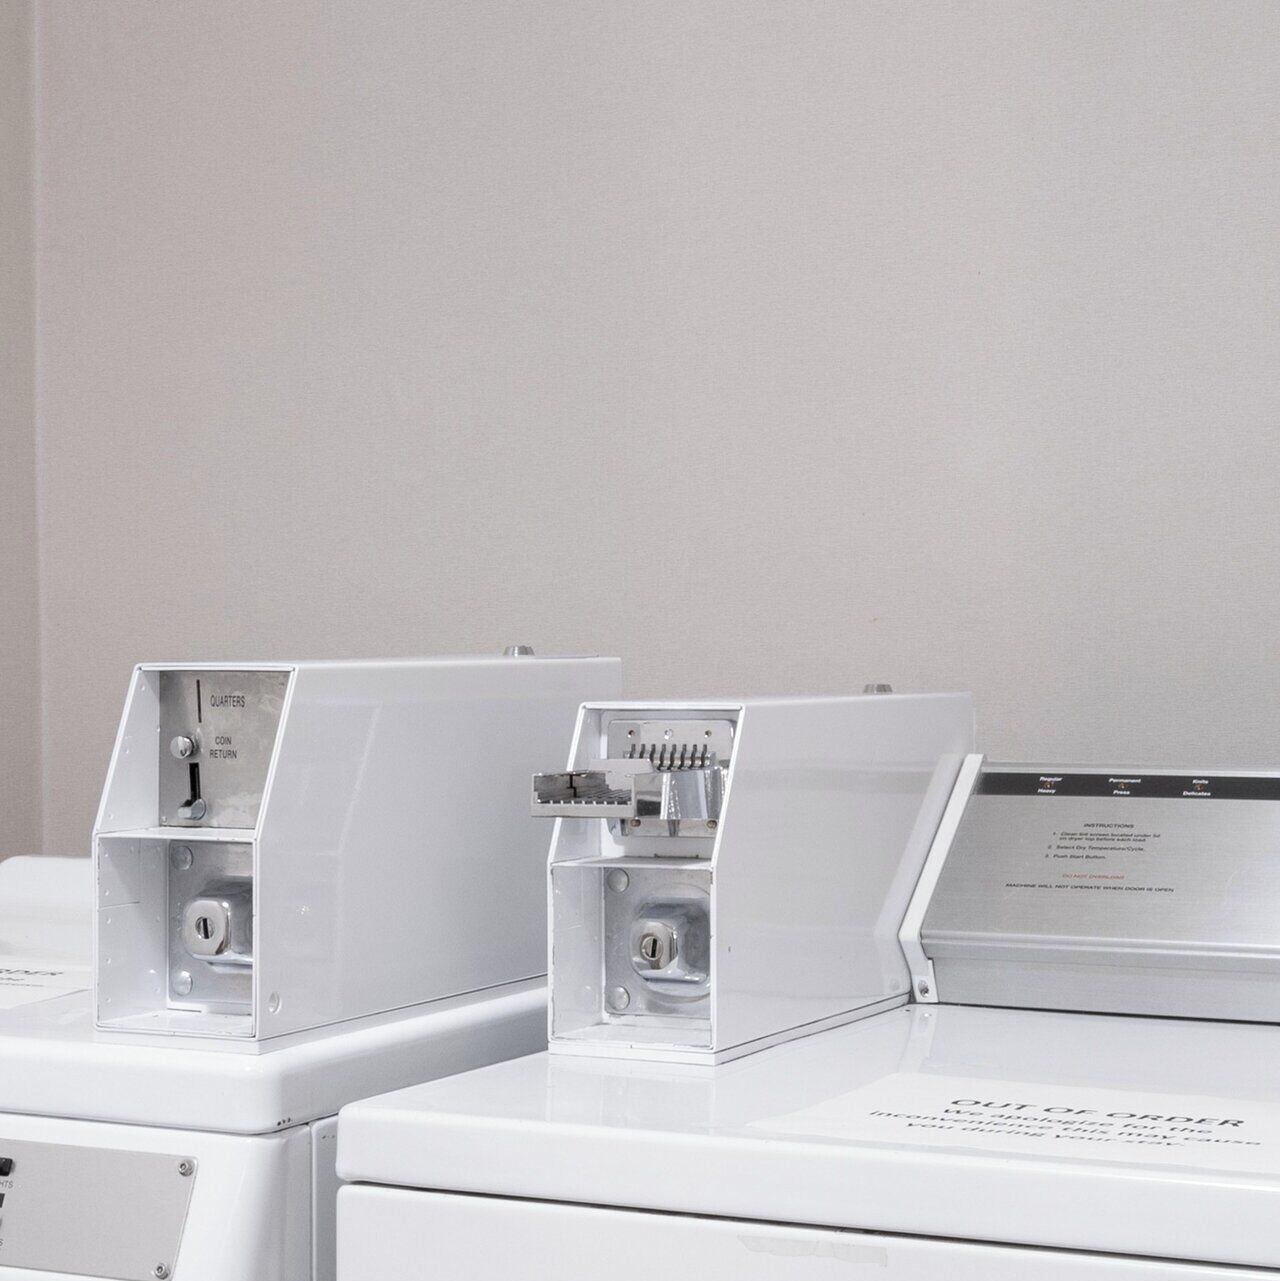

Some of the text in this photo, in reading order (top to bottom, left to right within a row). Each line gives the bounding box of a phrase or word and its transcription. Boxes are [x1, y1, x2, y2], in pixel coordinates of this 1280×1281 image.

[210, 694, 246, 708] QUARTERS
[215, 736, 232, 746] COIN
[209, 749, 238, 759] RETURN
[951, 1099, 1244, 1127] OUT OF ORDER
[990, 1114, 1114, 1126] apologize
[869, 1110, 1261, 1146] inconvenience this may cause
[961, 1127, 1045, 1138] during
